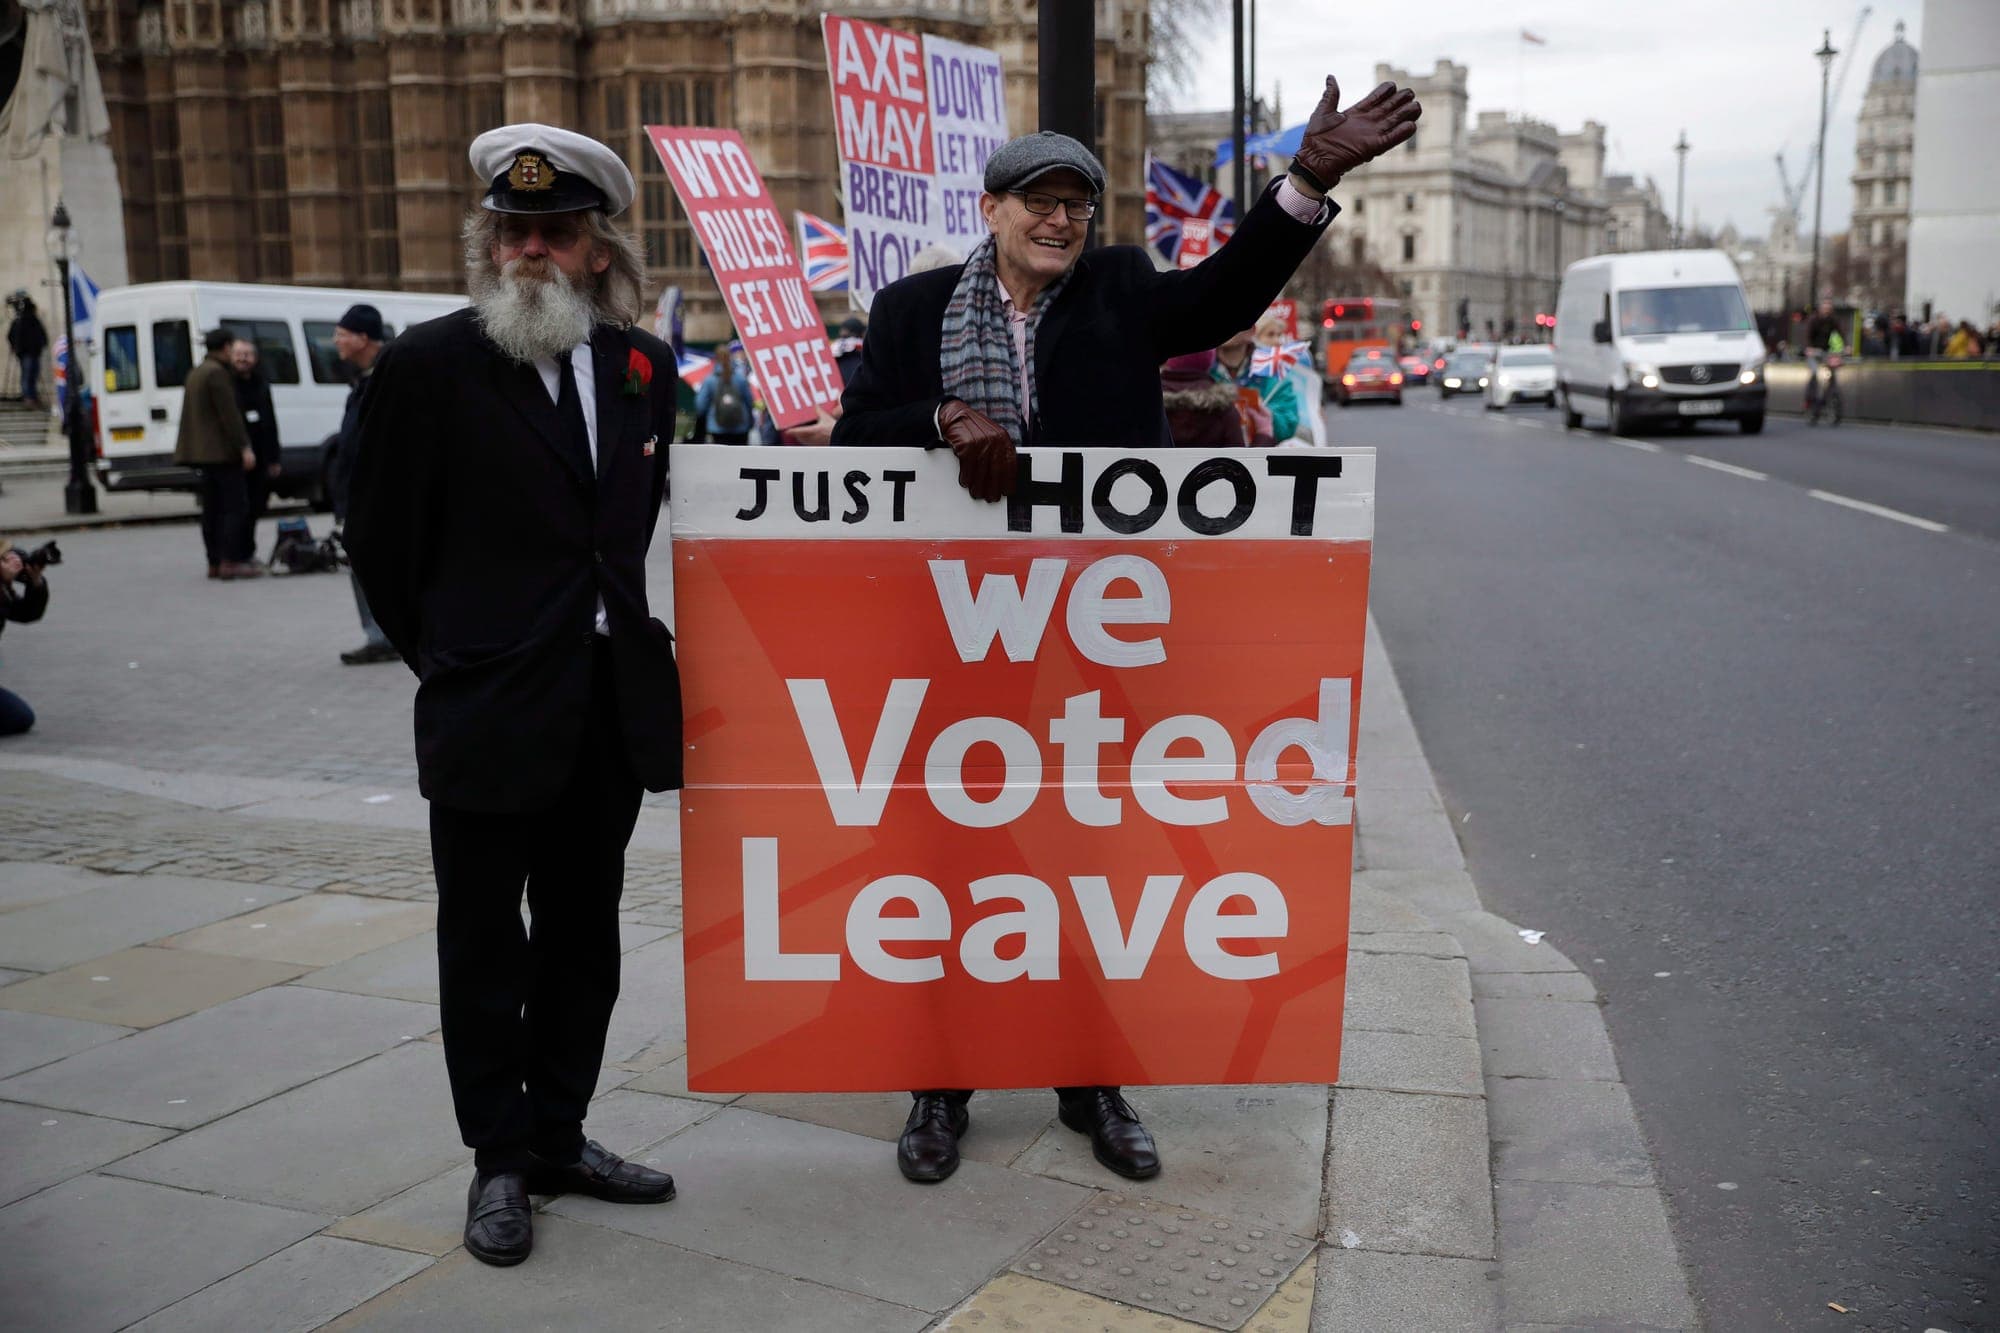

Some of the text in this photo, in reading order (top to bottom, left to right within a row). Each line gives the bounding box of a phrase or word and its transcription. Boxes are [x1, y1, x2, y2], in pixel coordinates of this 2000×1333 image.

[837, 20, 924, 104] AXE
[931, 53, 1000, 124] DON'T
[661, 138, 761, 199] WTO
[839, 94, 926, 170] MAY
[938, 131, 967, 175] LET
[849, 163, 928, 226] BREXIT
[697, 207, 793, 272] RULES!
[729, 277, 817, 338] SET UK
[755, 338, 840, 414] FREE
[735, 452, 1343, 536] JUST HOOT
[927, 554, 1172, 668] we
[785, 677, 1354, 828] Voted
[742, 836, 1289, 983] Leave
